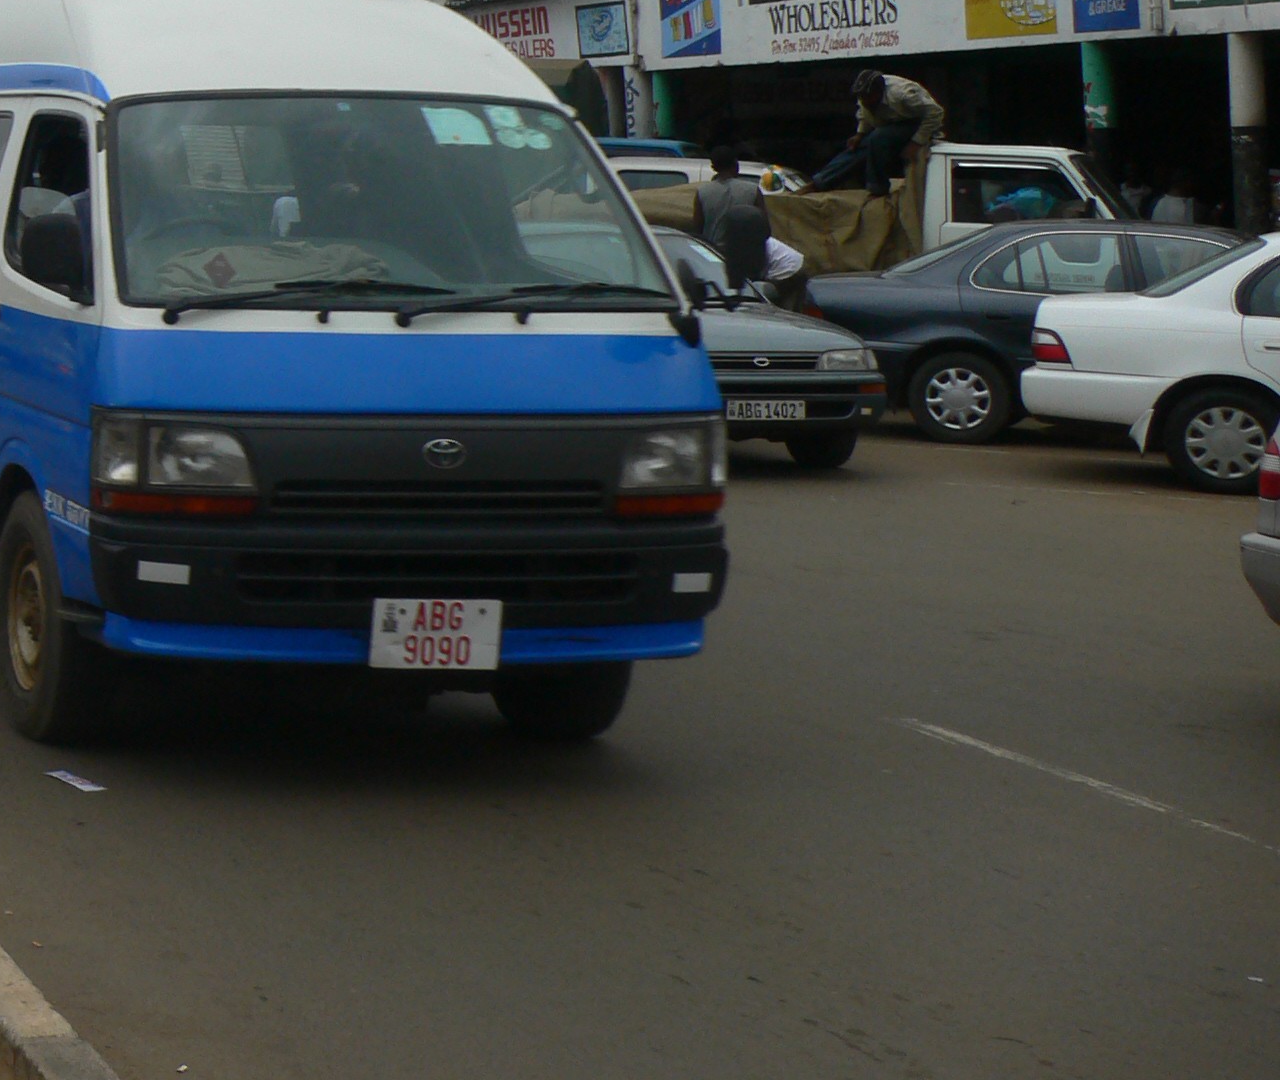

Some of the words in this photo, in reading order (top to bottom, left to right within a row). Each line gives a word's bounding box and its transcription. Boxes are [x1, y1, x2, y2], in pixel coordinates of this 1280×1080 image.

[821, 31, 858, 55] Lusaka
[737, 403, 762, 418] ABG
[765, 403, 796, 418] 1402
[413, 600, 464, 631] ABG
[404, 635, 471, 665] 9090
